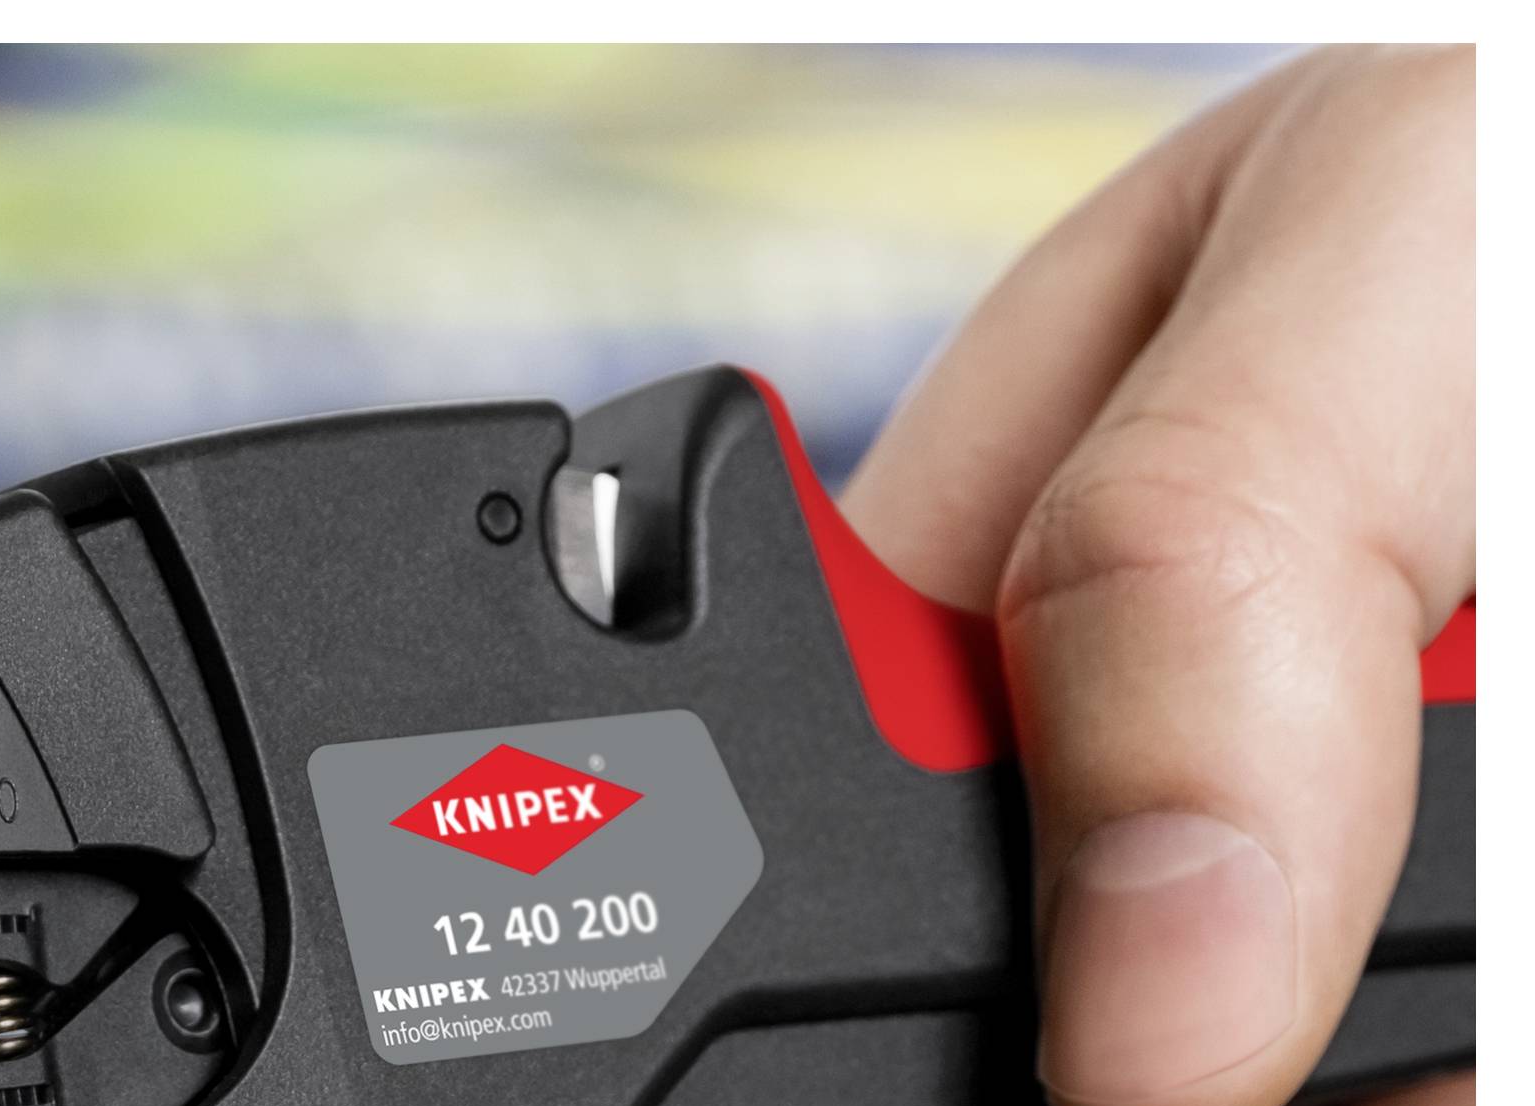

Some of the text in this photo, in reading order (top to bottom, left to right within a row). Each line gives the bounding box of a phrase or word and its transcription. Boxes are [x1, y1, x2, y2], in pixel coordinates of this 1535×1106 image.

[432, 784, 603, 836] KNIPEX
[433, 891, 659, 956] 12 40 200
[373, 956, 668, 1013] KNIPEX 42337 Wuppertal
[381, 1007, 553, 1048] info@knipex.com
